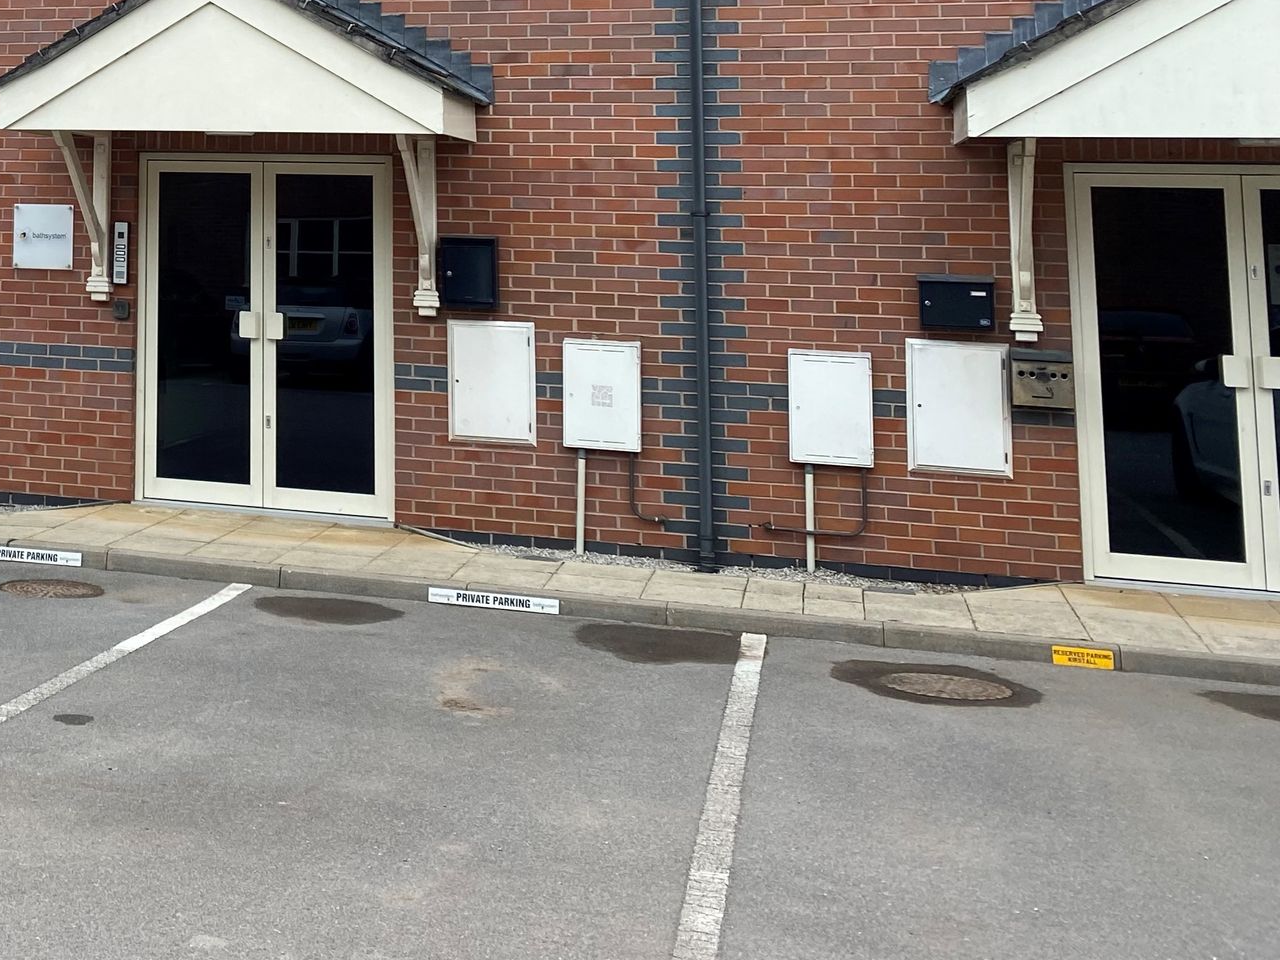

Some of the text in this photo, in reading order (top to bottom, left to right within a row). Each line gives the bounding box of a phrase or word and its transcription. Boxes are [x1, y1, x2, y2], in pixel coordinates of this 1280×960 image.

[26, 551, 58, 562] PARKING
[456, 592, 490, 605] PRIVATE
[493, 596, 531, 609] PARKING
